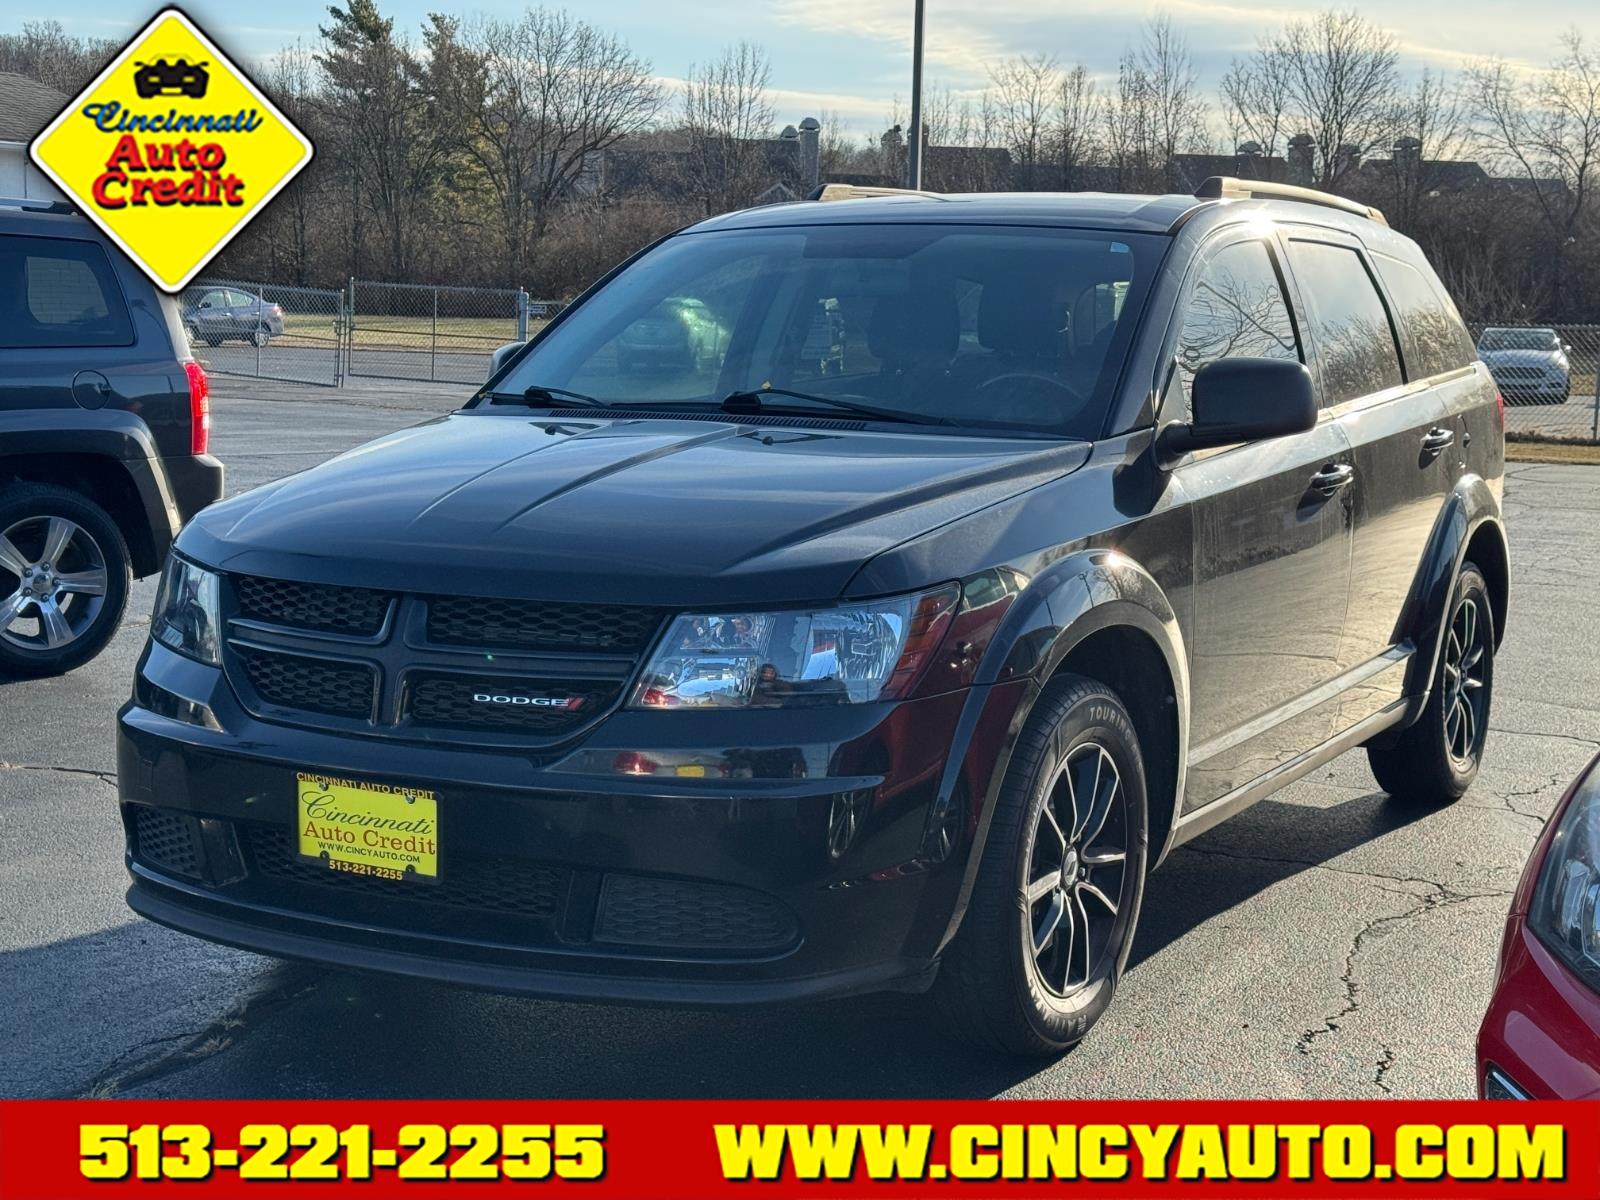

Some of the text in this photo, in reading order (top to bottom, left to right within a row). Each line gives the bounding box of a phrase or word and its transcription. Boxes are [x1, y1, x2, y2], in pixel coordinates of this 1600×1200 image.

[473, 694, 570, 707] DODGE
[1089, 705, 1132, 741] TOURING
[296, 771, 435, 800] CINCINNATI AUTO CREDIT
[301, 791, 435, 835] Cincinnati
[303, 821, 436, 855] Auto Credit
[318, 841, 420, 863] WWW.CINCYAUTO.COM
[329, 859, 403, 881] 513-221-2255
